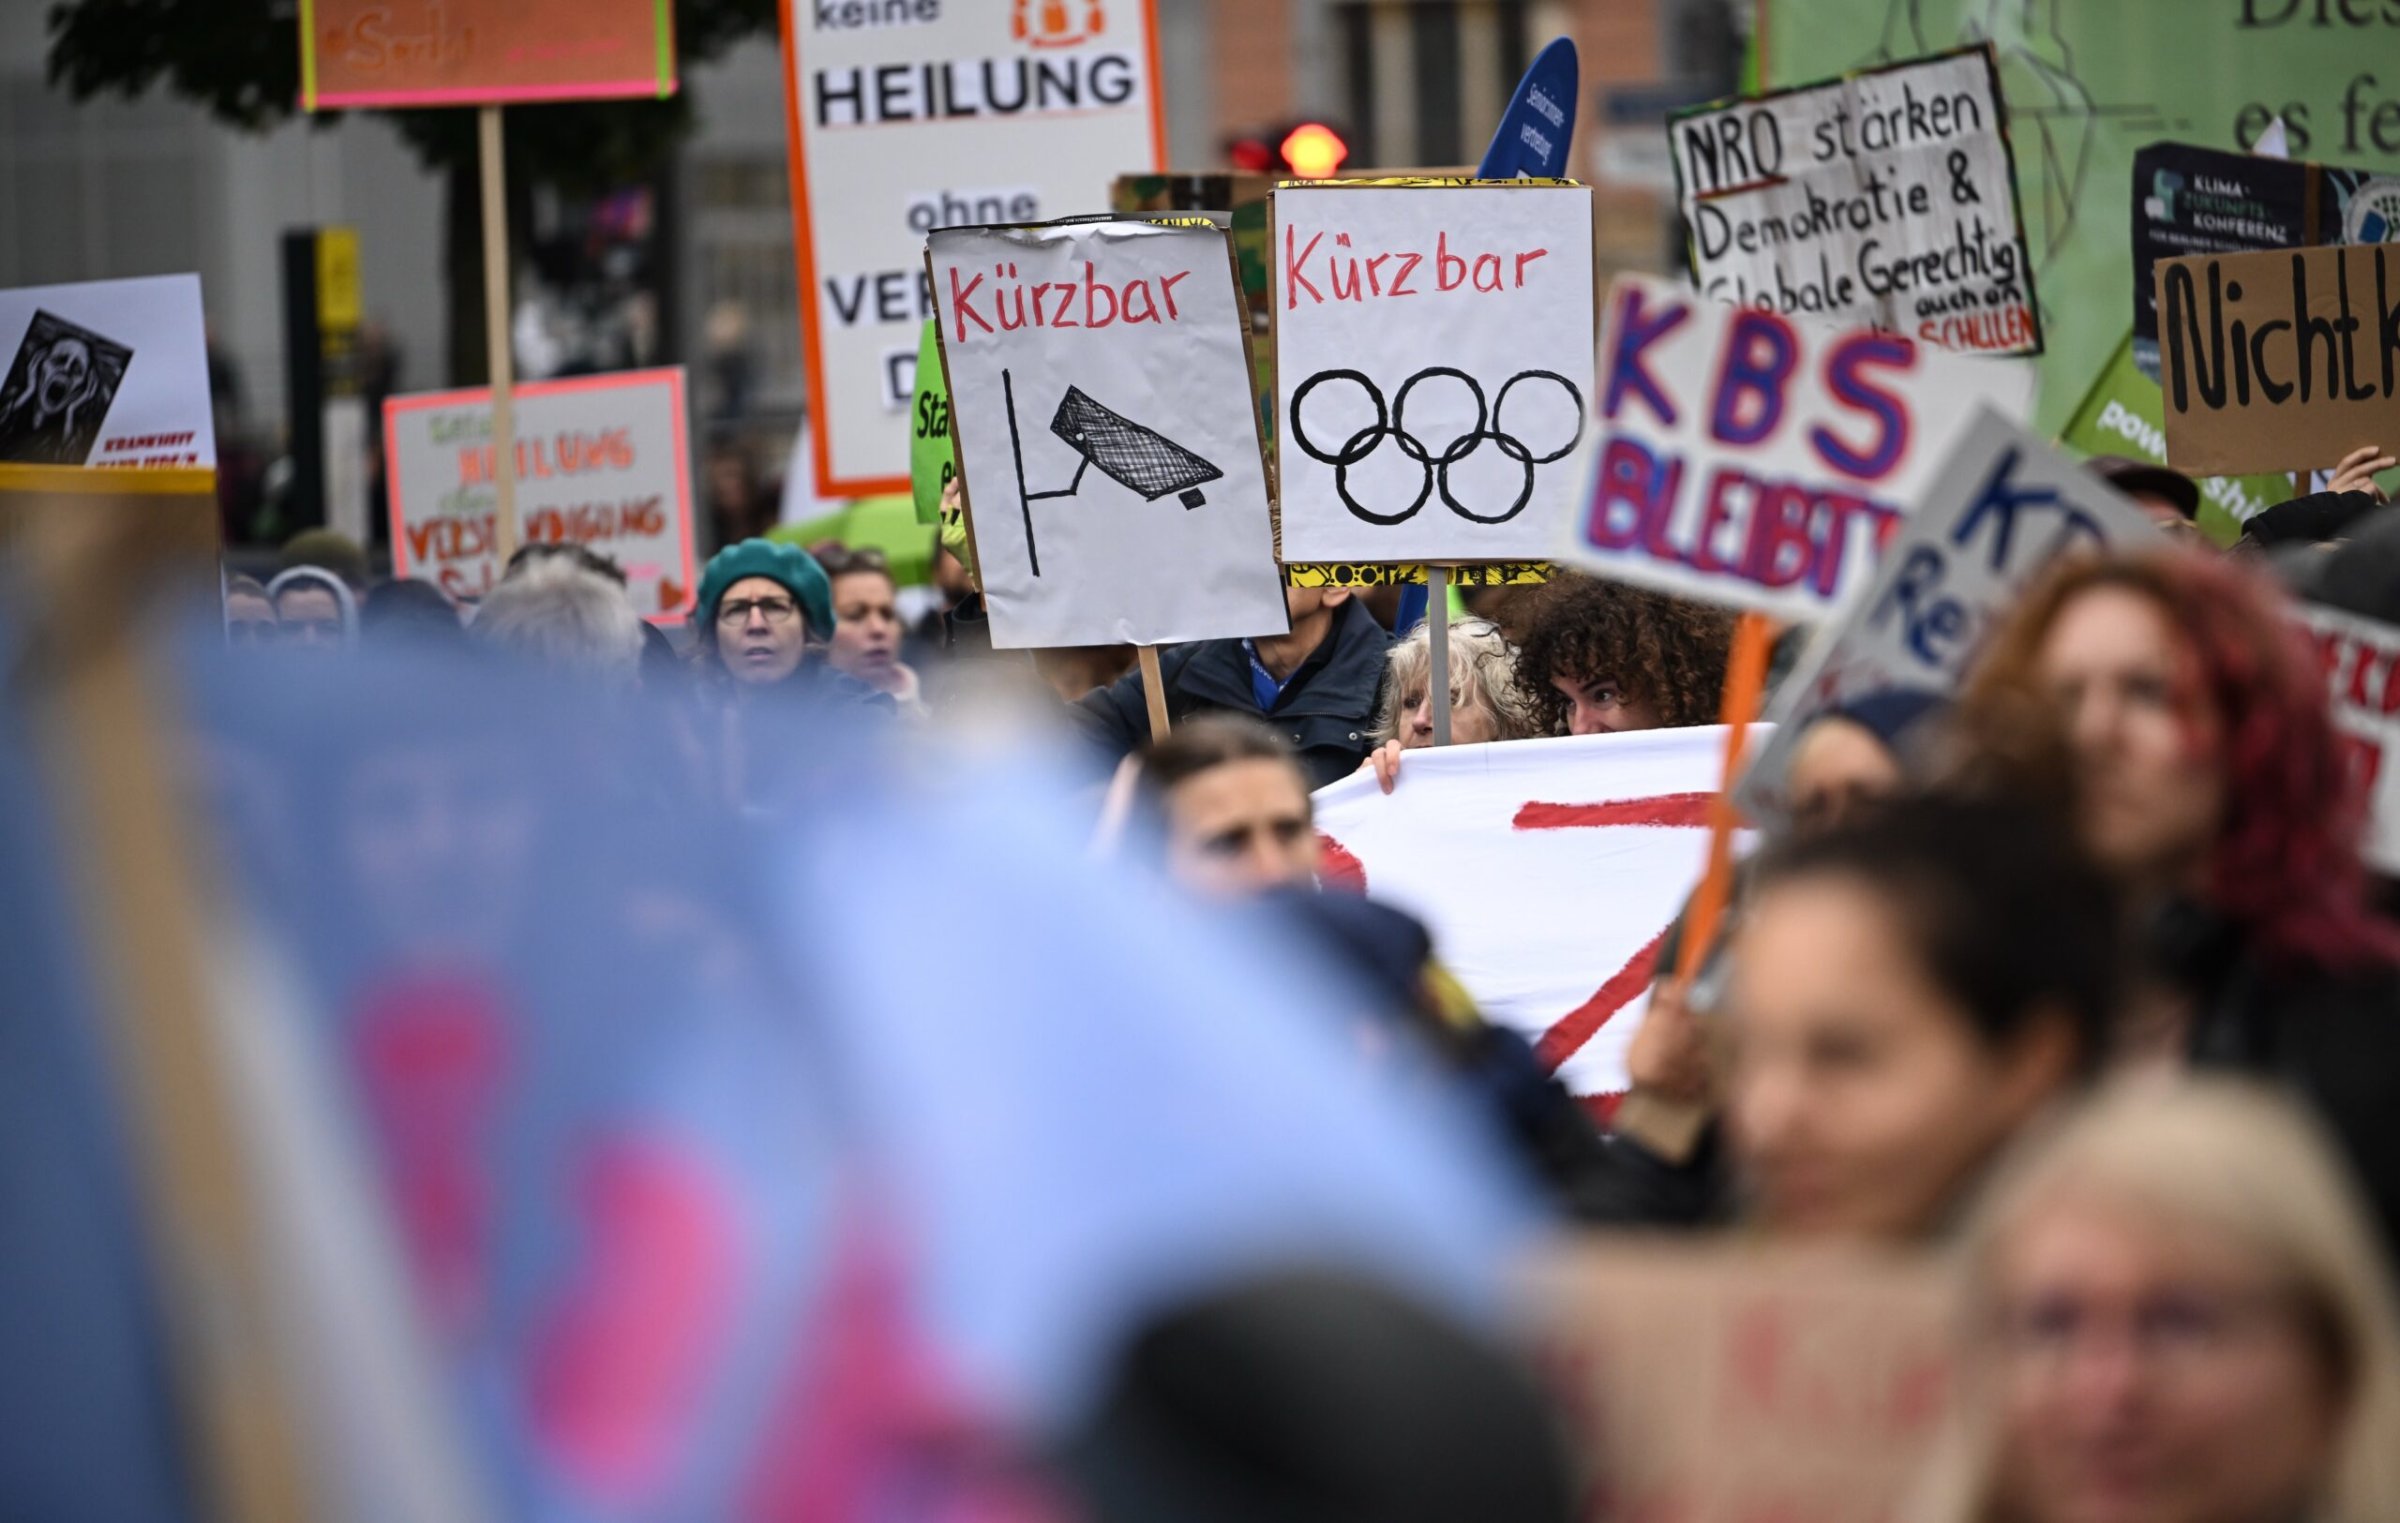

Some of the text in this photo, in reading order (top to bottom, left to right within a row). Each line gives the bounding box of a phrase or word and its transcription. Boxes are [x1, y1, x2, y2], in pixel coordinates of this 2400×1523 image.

[815, 0, 941, 29] keine
[815, 55, 1135, 127] HEILUNG
[1812, 82, 1982, 161] stärken
[2234, 102, 2311, 155] es
[907, 190, 1039, 235] ohne
[1696, 150, 1981, 261] Demokratie &
[2192, 212, 2288, 245] KONFERENZ
[949, 260, 1191, 343] Kürzbar
[1285, 224, 1548, 310] Kürzbar
[1914, 285, 2022, 318] auch an
[1918, 303, 2036, 350] SCHULEN
[1600, 283, 1917, 484] KBS
[406, 495, 667, 564] VERSTNDIGUNG
